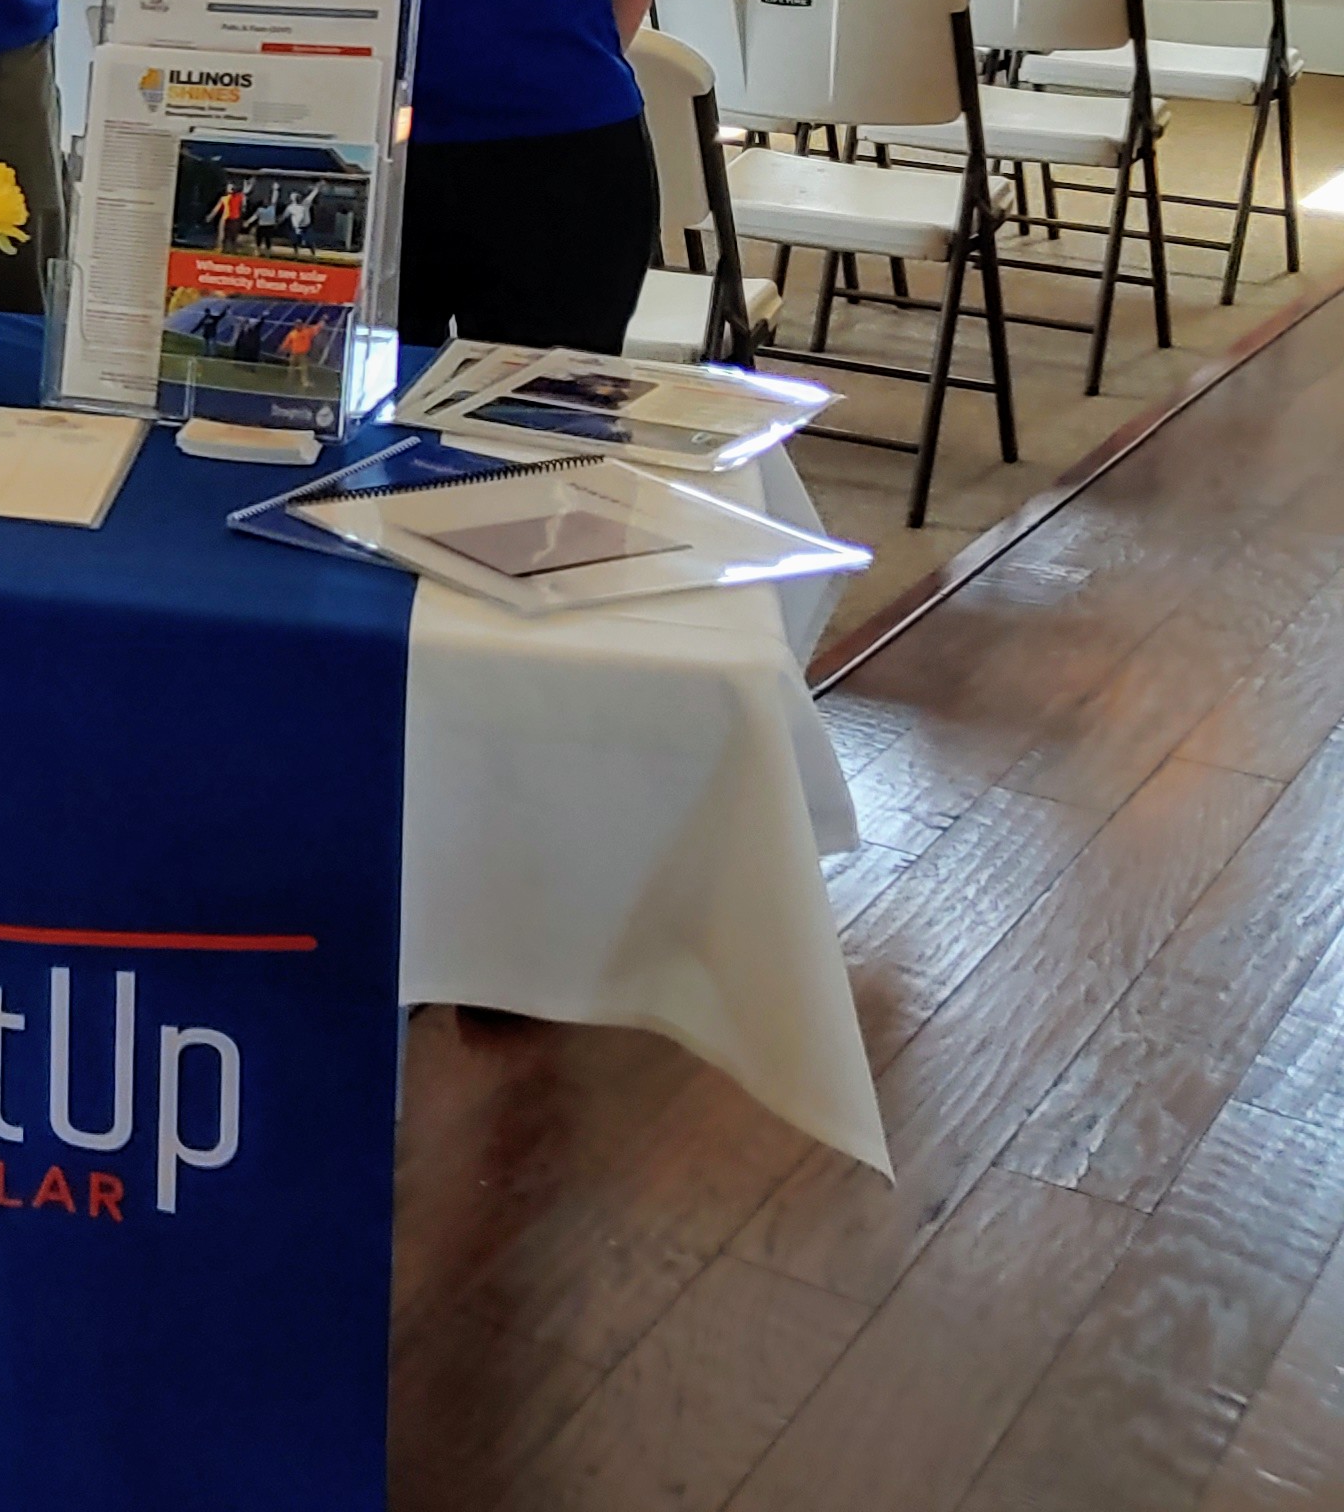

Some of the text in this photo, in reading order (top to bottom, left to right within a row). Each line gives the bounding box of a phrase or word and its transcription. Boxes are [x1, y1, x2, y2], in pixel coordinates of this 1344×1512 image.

[168, 69, 253, 88] ILLINOIS
[167, 86, 242, 103] SHINES
[196, 259, 233, 274] Where
[235, 263, 251, 275] do
[253, 267, 276, 279] you
